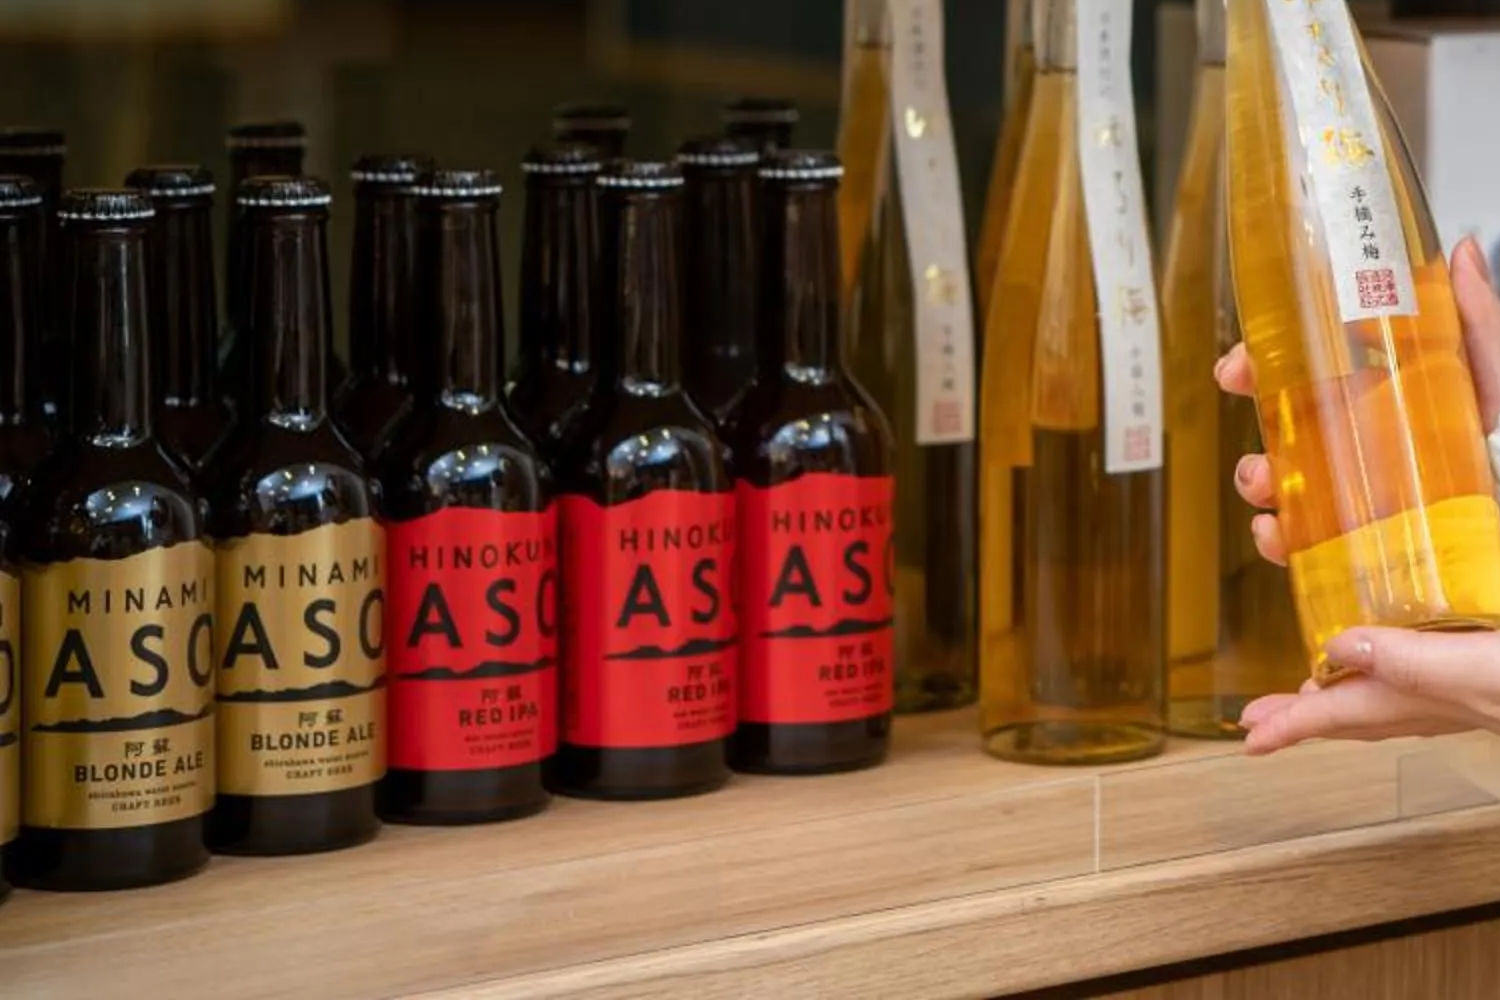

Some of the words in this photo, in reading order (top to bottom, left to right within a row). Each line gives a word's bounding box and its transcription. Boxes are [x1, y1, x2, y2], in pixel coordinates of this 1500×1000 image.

[244, 555, 379, 589] MINAMI
[68, 578, 208, 615] MINAMI
[407, 568, 557, 649] ASO
[615, 557, 737, 629] AS
[222, 588, 385, 669] ASO
[45, 612, 214, 699] ASO
[819, 663, 857, 682] RED
[668, 684, 707, 704] RED
[458, 705, 502, 728] RED
[509, 701, 538, 722] IPA
[251, 729, 340, 752] BLONDE
[346, 722, 376, 744] ALE
[75, 759, 167, 783] BLONDE
[173, 751, 204, 776] ALE
